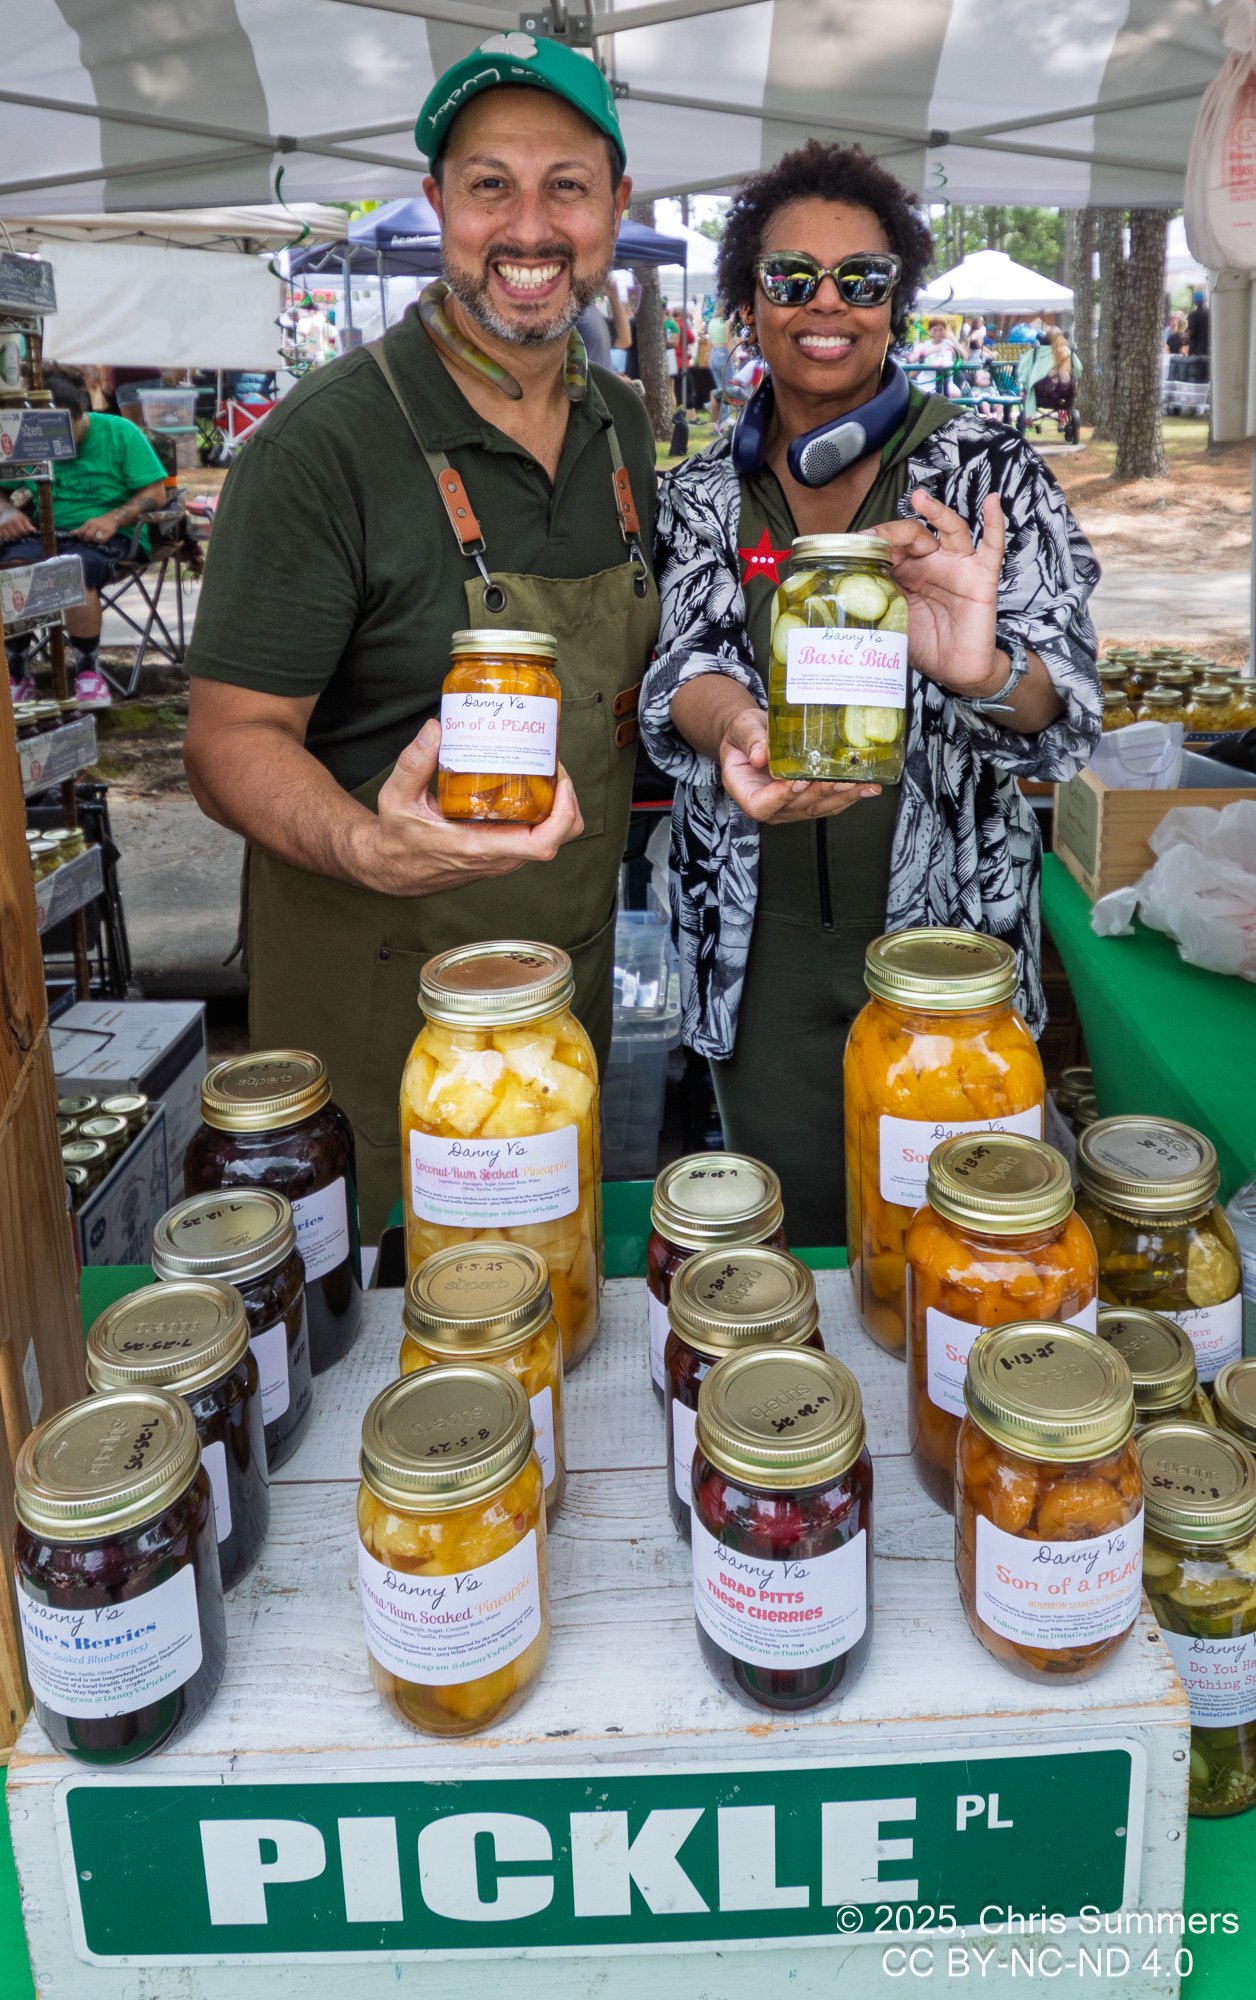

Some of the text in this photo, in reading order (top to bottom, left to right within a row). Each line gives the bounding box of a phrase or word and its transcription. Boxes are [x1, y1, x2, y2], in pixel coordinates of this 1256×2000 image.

[428, 67, 500, 129] Lucky
[822, 628, 884, 650] Danny V's
[798, 646, 900, 670] Basic Bitch
[462, 694, 528, 717] Danny V's
[445, 717, 546, 734] Son of a PEACH
[448, 1141, 528, 1167] Danny V's
[415, 1158, 569, 1181] Coconut-Rum Soaked Pineapple
[1186, 1328, 1212, 1339] Have
[1195, 1335, 1224, 1351] picy?
[945, 1343, 968, 1366] So
[714, 1542, 810, 1590] Danny V's
[1032, 1534, 1128, 1575] Danny V's
[996, 1548, 1142, 1595] Son of a PEAC
[383, 1571, 483, 1610] Danny V's
[719, 1571, 805, 1604] BRAD PITTS
[1028, 1584, 1132, 1610] BOURBON SOAKED PEACHES
[420, 1608, 473, 1625] Soaked
[474, 1574, 531, 1616] Pineapple
[28, 1600, 124, 1637] Danny V's
[446, 1624, 469, 1633] Coconut
[469, 1620, 484, 1628] Rum,
[485, 1611, 501, 1621] Water
[993, 1614, 1019, 1633] Follow
[1050, 1630, 1095, 1639] InstaGram
[75, 1622, 157, 1650] Berries
[417, 1632, 437, 1640] Vanilla,
[730, 1634, 771, 1655] Instagram
[54, 1642, 148, 1665] Soaked Blueberries)
[102, 1669, 135, 1681] inspected
[160, 1634, 193, 1661] Department
[1189, 1638, 1247, 1663] Danny
[405, 1659, 449, 1672] Instagram
[1189, 1661, 1208, 1674] Do
[1212, 1663, 1239, 1675] You
[52, 1668, 177, 1704] Instagram @DannyVsPickles
[73, 1688, 87, 1696] Way
[99, 1679, 120, 1688] health
[1181, 1677, 1241, 1691] nything
[1197, 1710, 1238, 1718] InstaGram
[199, 1795, 1014, 1926] PICKLE PL
